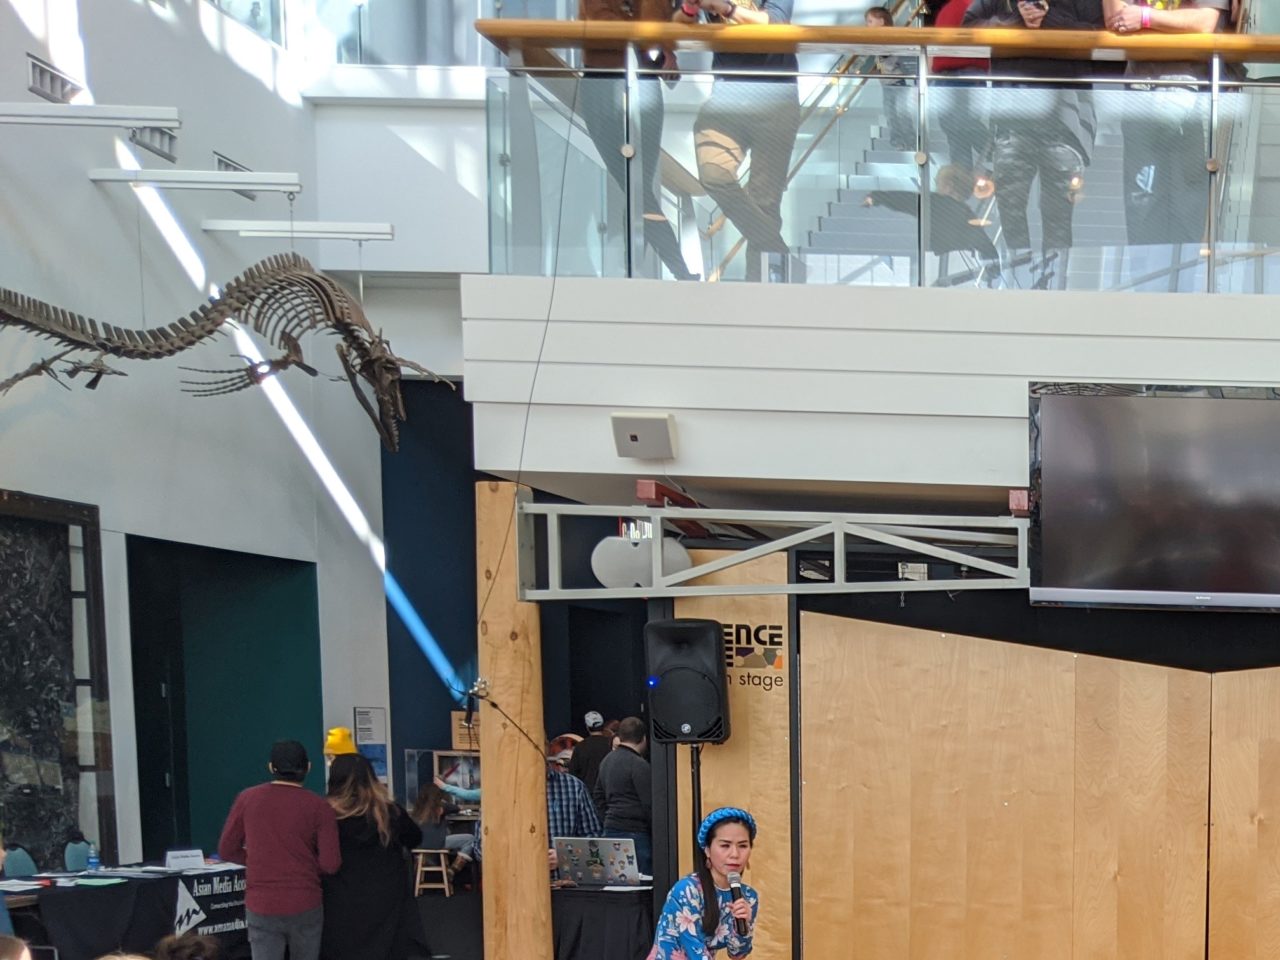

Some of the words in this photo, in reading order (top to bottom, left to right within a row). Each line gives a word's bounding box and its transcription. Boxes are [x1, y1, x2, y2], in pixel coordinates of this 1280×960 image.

[739, 672, 784, 691] stage
[193, 879, 211, 896] Asian
[213, 877, 232, 894] Media
